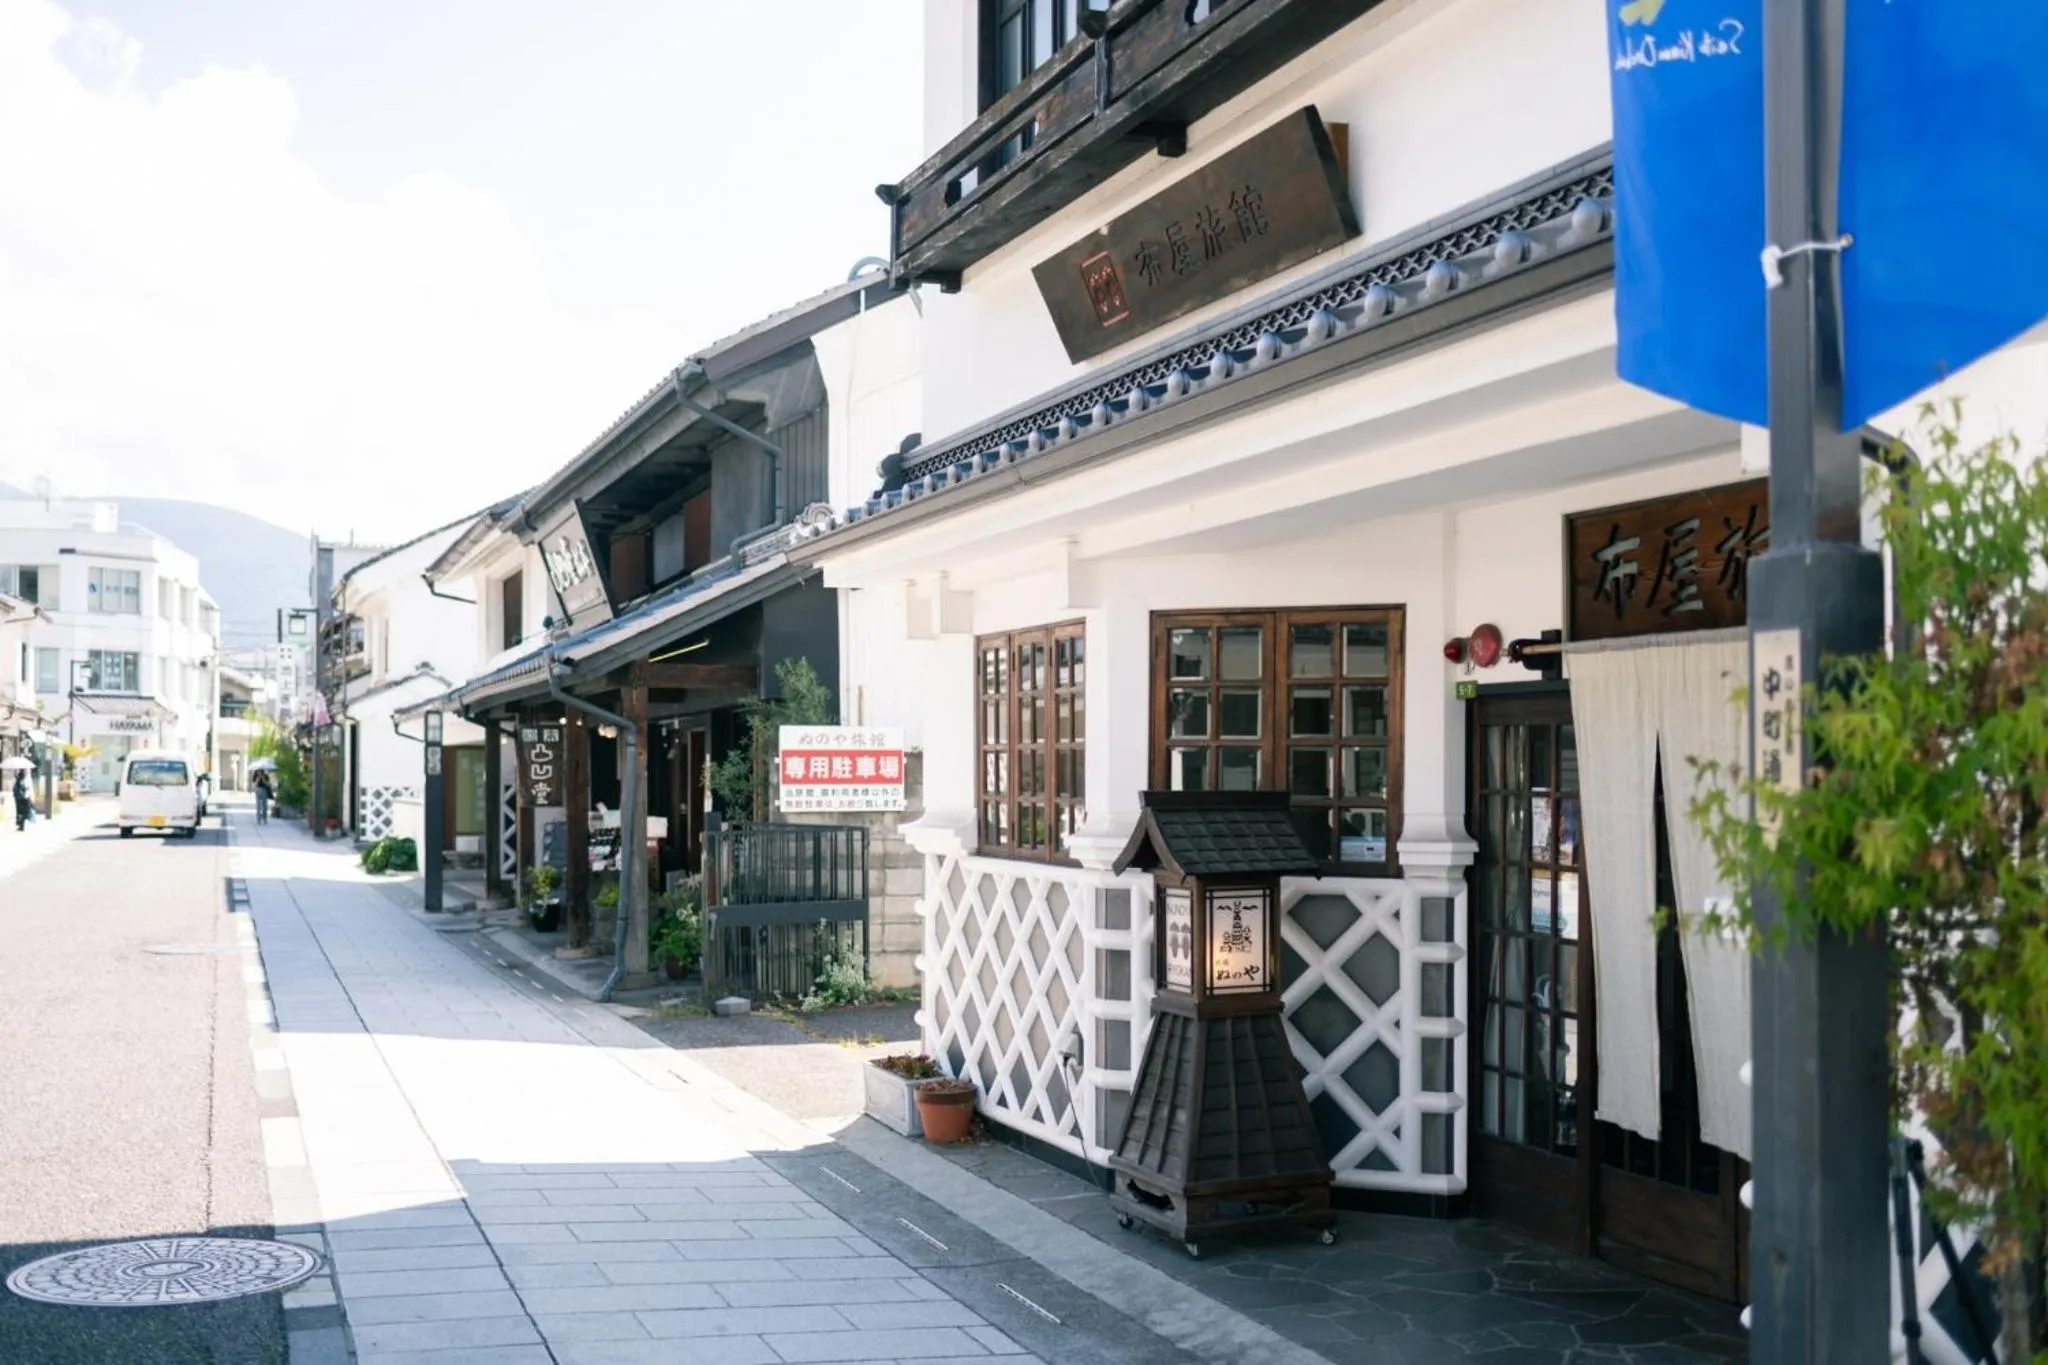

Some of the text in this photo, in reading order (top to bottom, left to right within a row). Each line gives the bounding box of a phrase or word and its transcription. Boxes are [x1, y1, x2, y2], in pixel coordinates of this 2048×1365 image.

[530, 743, 553, 804] 凸凹堂
[784, 755, 900, 780] 専用駐車場
[1216, 964, 1261, 982] ぬのや
